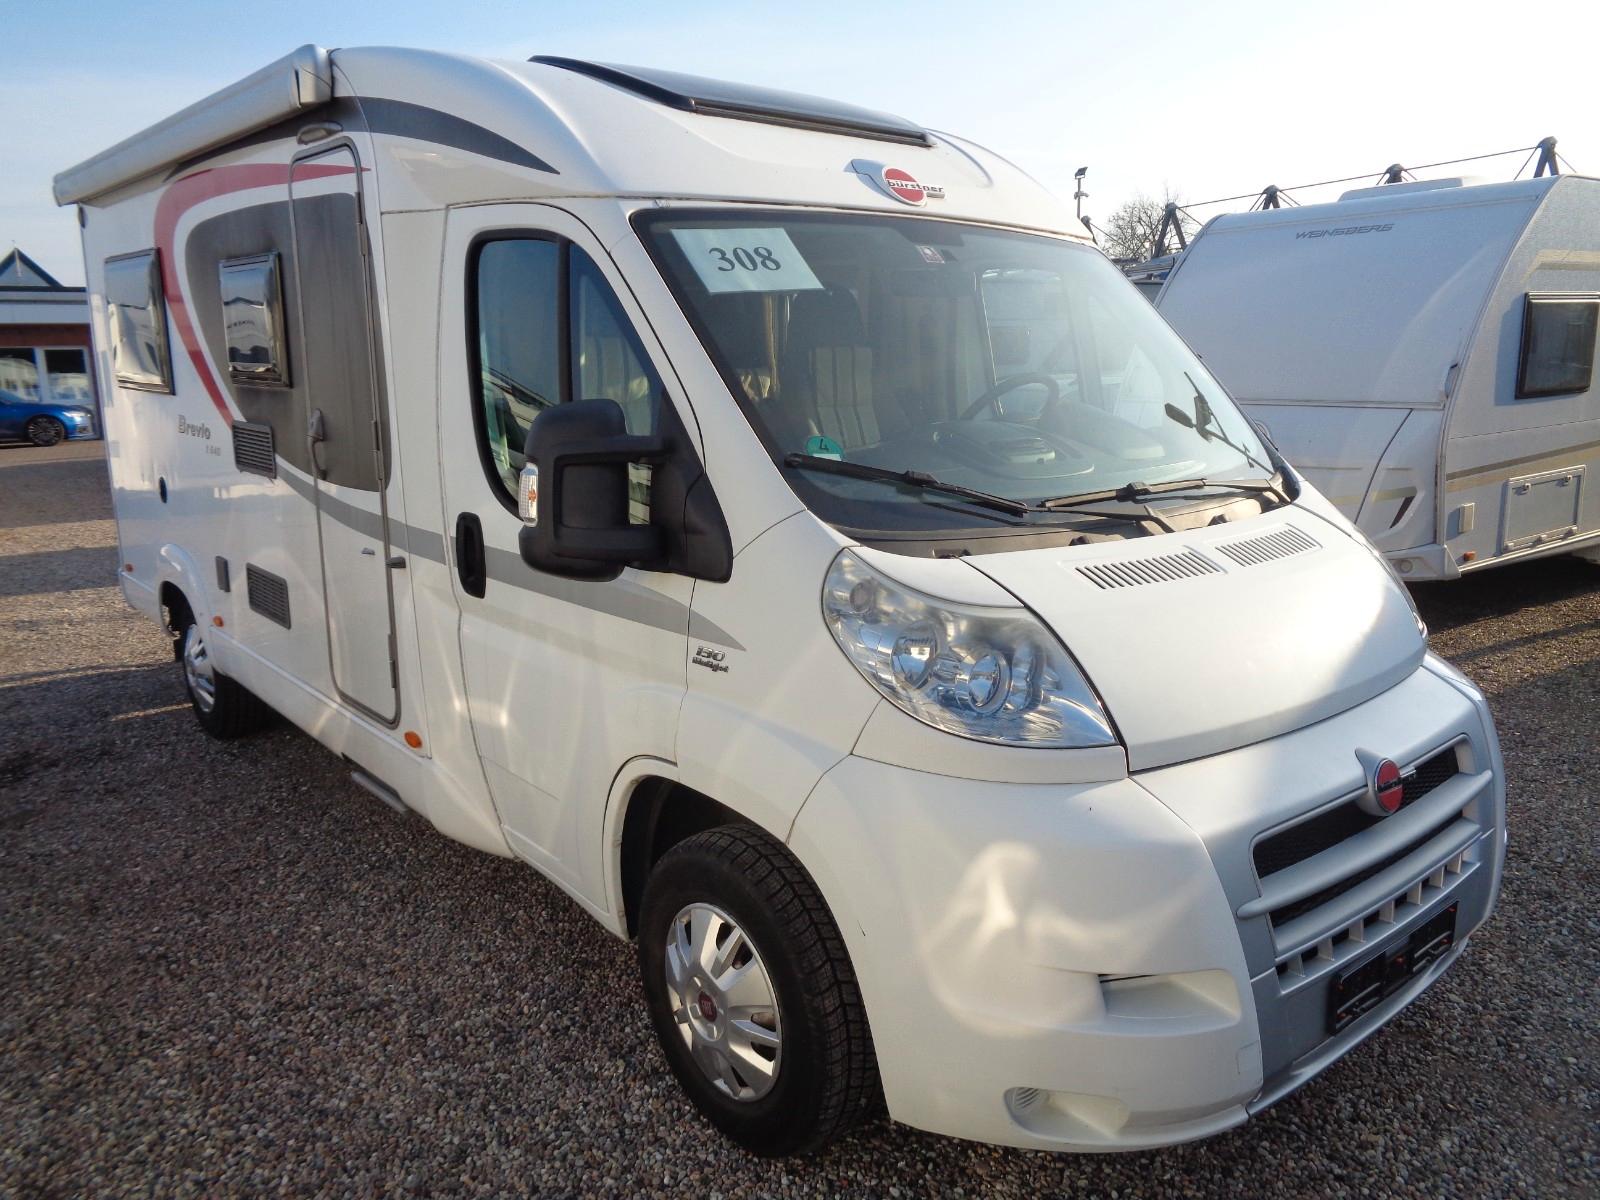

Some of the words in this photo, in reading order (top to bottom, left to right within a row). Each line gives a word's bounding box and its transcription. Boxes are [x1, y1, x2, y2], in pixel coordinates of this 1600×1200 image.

[886, 179, 944, 193] bürstner
[1296, 223, 1394, 239] WEINSBERG
[709, 246, 781, 272] 308
[178, 414, 211, 440] Brevio
[819, 438, 830, 452] 4
[695, 645, 726, 662] 130
